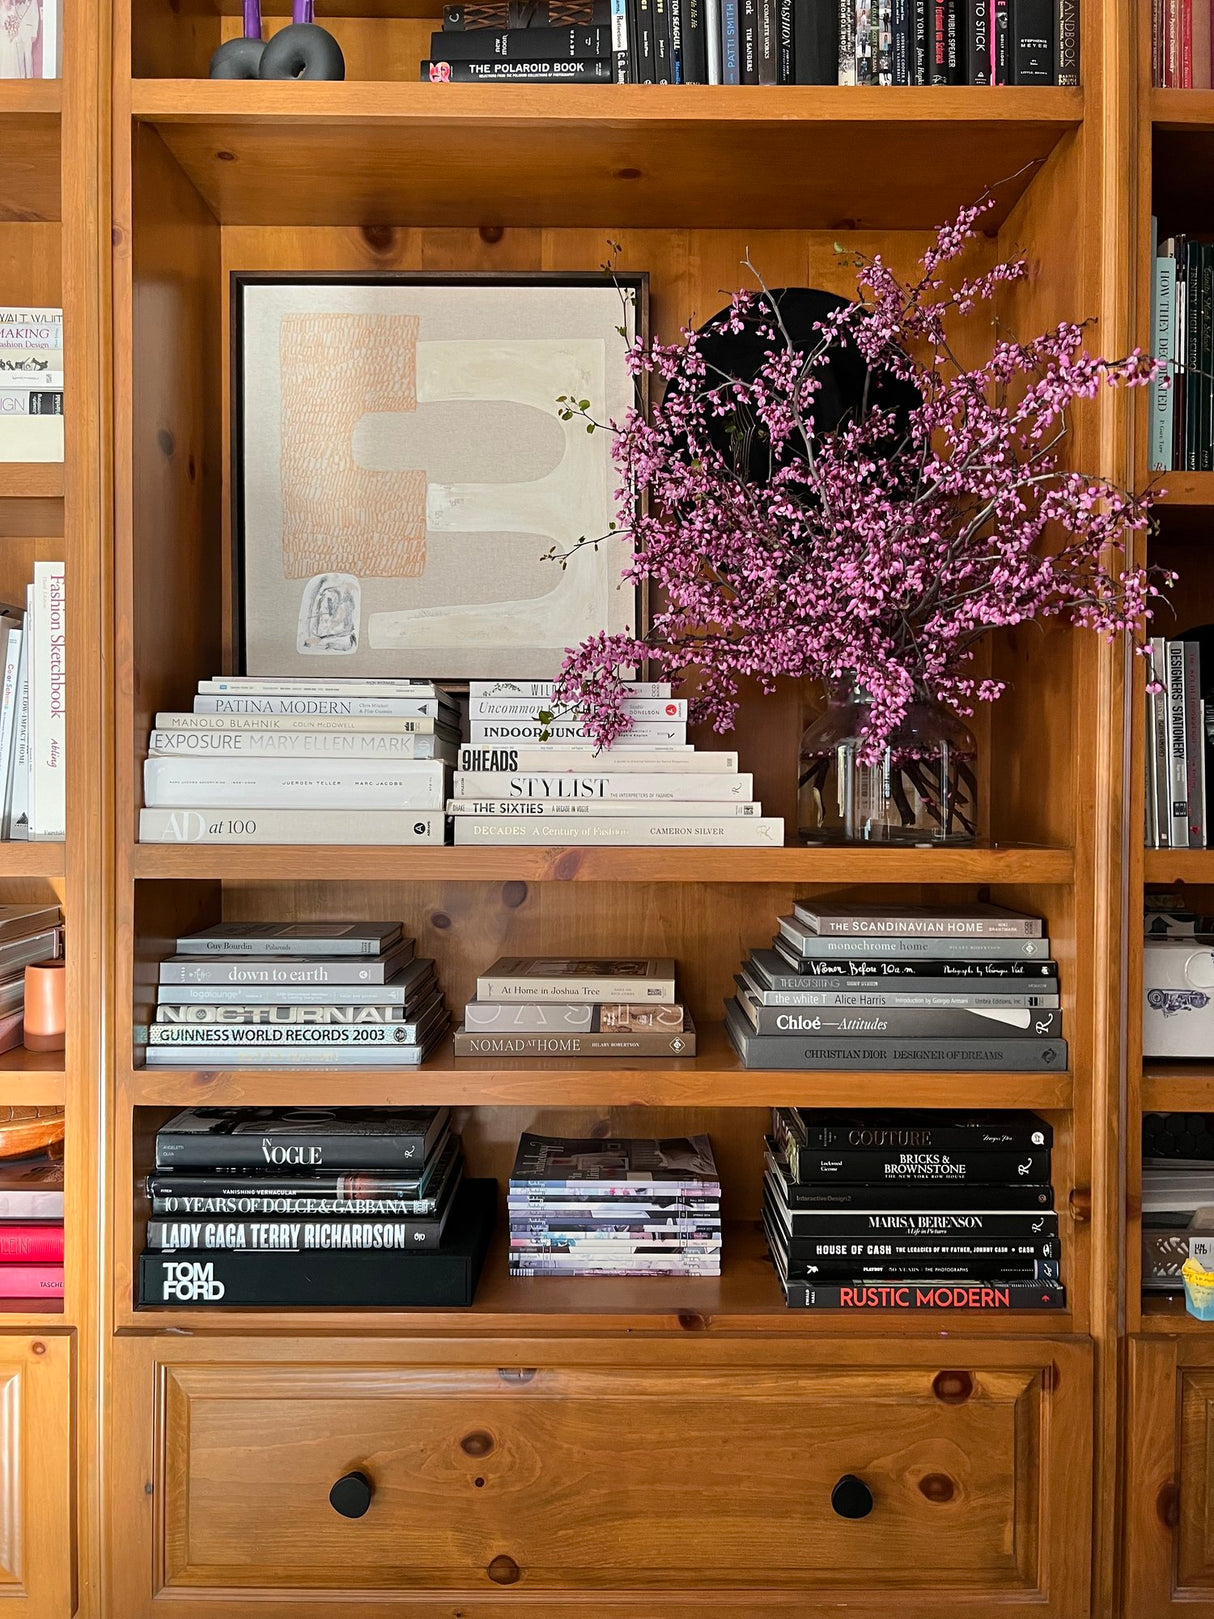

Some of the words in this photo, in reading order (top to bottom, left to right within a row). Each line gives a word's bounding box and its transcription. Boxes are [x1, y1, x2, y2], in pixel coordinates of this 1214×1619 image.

[976, 2, 985, 17] TO
[726, 4, 735, 35] SMITH
[616, 16, 624, 48] Reflections
[672, 16, 680, 50] SEAGULL
[976, 20, 986, 51] STICK
[617, 52, 625, 60] C.
[727, 39, 736, 68] PATTI
[916, 47, 924, 65] Johns
[948, 39, 956, 68] SPEAKER
[469, 64, 490, 74] THE
[494, 63, 550, 73] POLAROID
[554, 62, 584, 72] BOOK
[618, 60, 626, 68] G.
[1160, 270, 1169, 298] HOW
[1190, 266, 1198, 306] TRINITY
[1159, 301, 1169, 335] THEY
[1190, 309, 1198, 333] HIGH
[26, 341, 49, 350] Design
[50, 575, 65, 630] Fashion
[50, 634, 65, 719] Sketchbook
[216, 700, 274, 712] PATINA
[280, 701, 352, 714] MODERN
[479, 702, 544, 714] Uncommon
[172, 719, 224, 728] MANOLO
[230, 719, 280, 728] BLAHNIK
[484, 728, 542, 738] INDOOR
[1172, 706, 1184, 759] STATIONERY
[154, 734, 242, 749] EXPOSURE
[250, 735, 299, 750] MARY
[304, 736, 355, 751] ELLEN
[361, 737, 411, 751] MARK
[47, 738, 60, 768] Abling
[462, 750, 518, 772] 9HEADS
[510, 778, 609, 798] STYLIST
[473, 803, 495, 813] THE
[500, 803, 544, 814] SIXTIES
[160, 811, 206, 842] AD
[209, 821, 223, 834] at
[227, 819, 257, 834] 100
[474, 826, 526, 835] DECADES
[533, 826, 540, 835] A
[542, 826, 579, 837] Century
[581, 826, 590, 836] of
[830, 923, 849, 931] THE
[852, 922, 944, 932] SCANDINAVIAN
[948, 922, 983, 932] HOME
[206, 942, 221, 951] Guy
[224, 942, 253, 950] Bourdin
[828, 941, 896, 951] monochrome
[900, 941, 928, 951] home
[228, 966, 268, 981] down
[272, 968, 287, 981] to
[290, 966, 328, 981] earth
[501, 987, 512, 995] At
[514, 987, 538, 995] Home
[540, 987, 549, 995] in
[551, 987, 579, 996] Joshua
[582, 987, 600, 995] Tree
[775, 994, 790, 1004] the
[792, 994, 819, 1004] white
[821, 995, 828, 1004] T
[834, 995, 857, 1004] Alice
[860, 995, 886, 1005] Harris
[156, 1005, 406, 1024] NOCTURNAL
[776, 1014, 821, 1030] Chloé
[160, 1029, 229, 1041] GUINNESS
[232, 1029, 283, 1041] WORLD
[286, 1029, 349, 1041] RECORDS
[353, 1029, 385, 1040] 2003
[470, 1039, 525, 1051] NOMAD
[525, 1039, 537, 1047] AT
[537, 1039, 580, 1051] HOME
[804, 1050, 861, 1059] CHRISTIAN
[863, 1050, 887, 1059] DIOR
[894, 1051, 945, 1060] DESIGNER
[946, 1051, 959, 1060] OF
[959, 1051, 1004, 1060] DREAMS
[262, 1138, 272, 1146] IN
[849, 1130, 932, 1146] COUTURE
[262, 1147, 322, 1164] VOGUE
[900, 1154, 940, 1164] BRICKS
[942, 1155, 950, 1164] &
[885, 1164, 966, 1174] BROWNSTONE
[163, 1198, 178, 1212] 10
[184, 1199, 236, 1212] YEARS
[239, 1199, 260, 1213] OF
[262, 1199, 318, 1213] DOLCE
[332, 1200, 408, 1214] GABBANA
[868, 1216, 915, 1228] MARISA
[918, 1216, 983, 1228] BERENSON
[162, 1224, 201, 1248] LADY
[205, 1224, 246, 1248] GAGA
[250, 1224, 301, 1248] TERRY
[304, 1224, 405, 1249] RICHARDSON
[816, 1245, 847, 1254] HOUSE
[851, 1245, 864, 1254] OF
[867, 1245, 892, 1254] CASH
[162, 1262, 213, 1281] TOM
[162, 1281, 225, 1300] FORD
[840, 1288, 909, 1307] RUSTIC
[916, 1288, 1010, 1307] MODERN
